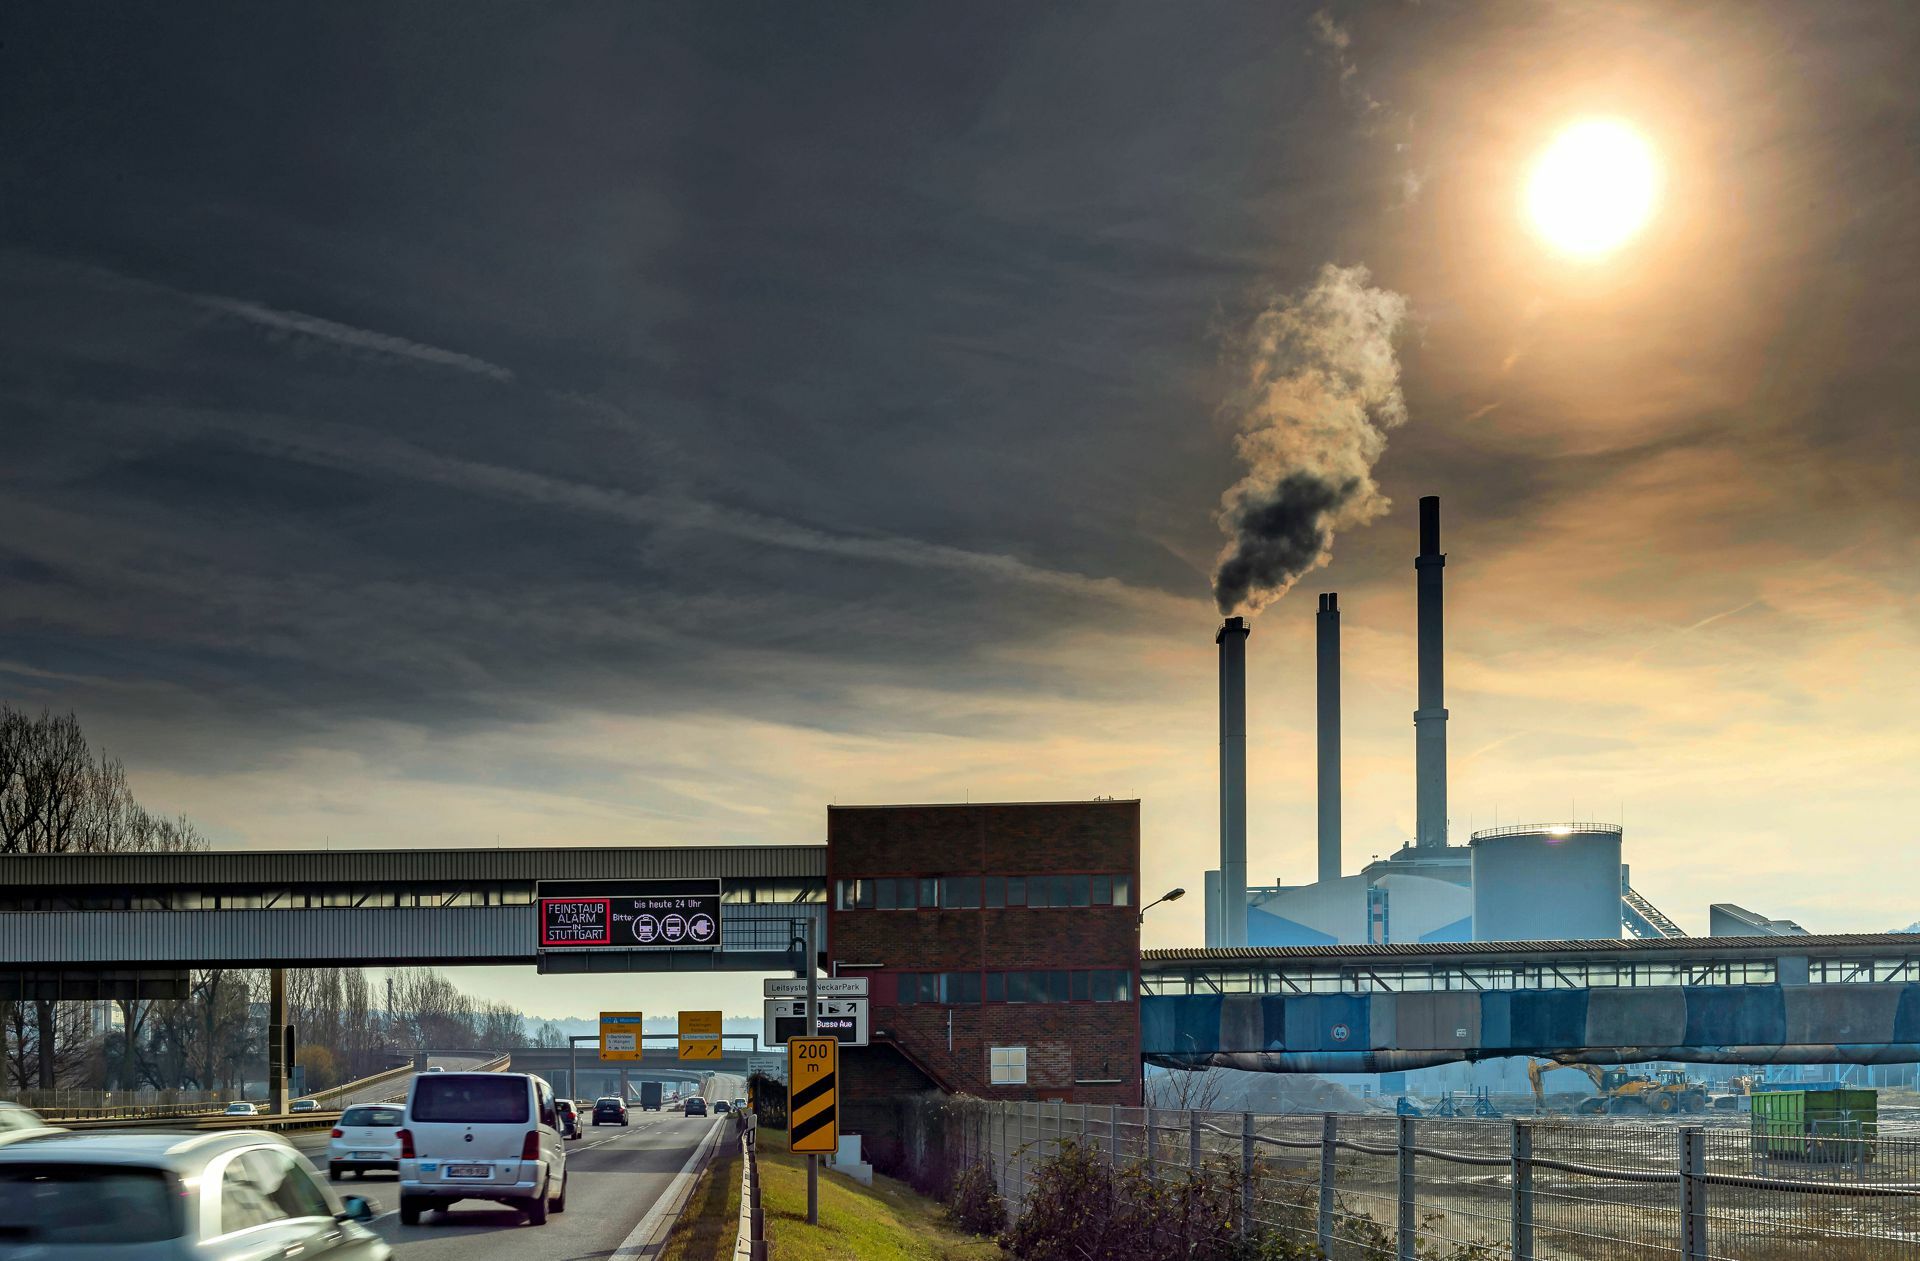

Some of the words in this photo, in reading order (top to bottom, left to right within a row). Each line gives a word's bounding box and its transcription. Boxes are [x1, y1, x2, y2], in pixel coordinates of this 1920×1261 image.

[634, 900, 646, 908] bis
[649, 900, 672, 908] heute
[675, 900, 685, 908] 24
[688, 900, 702, 908] Uhr
[548, 904, 604, 914] FEINSTAUB
[558, 914, 596, 923] ALARM
[549, 930, 604, 940] STUTTGART
[771, 984, 808, 992] Leitsyste
[817, 983, 860, 991] NeckarPark
[798, 1044, 828, 1059] 200
[807, 1063, 819, 1072] m
